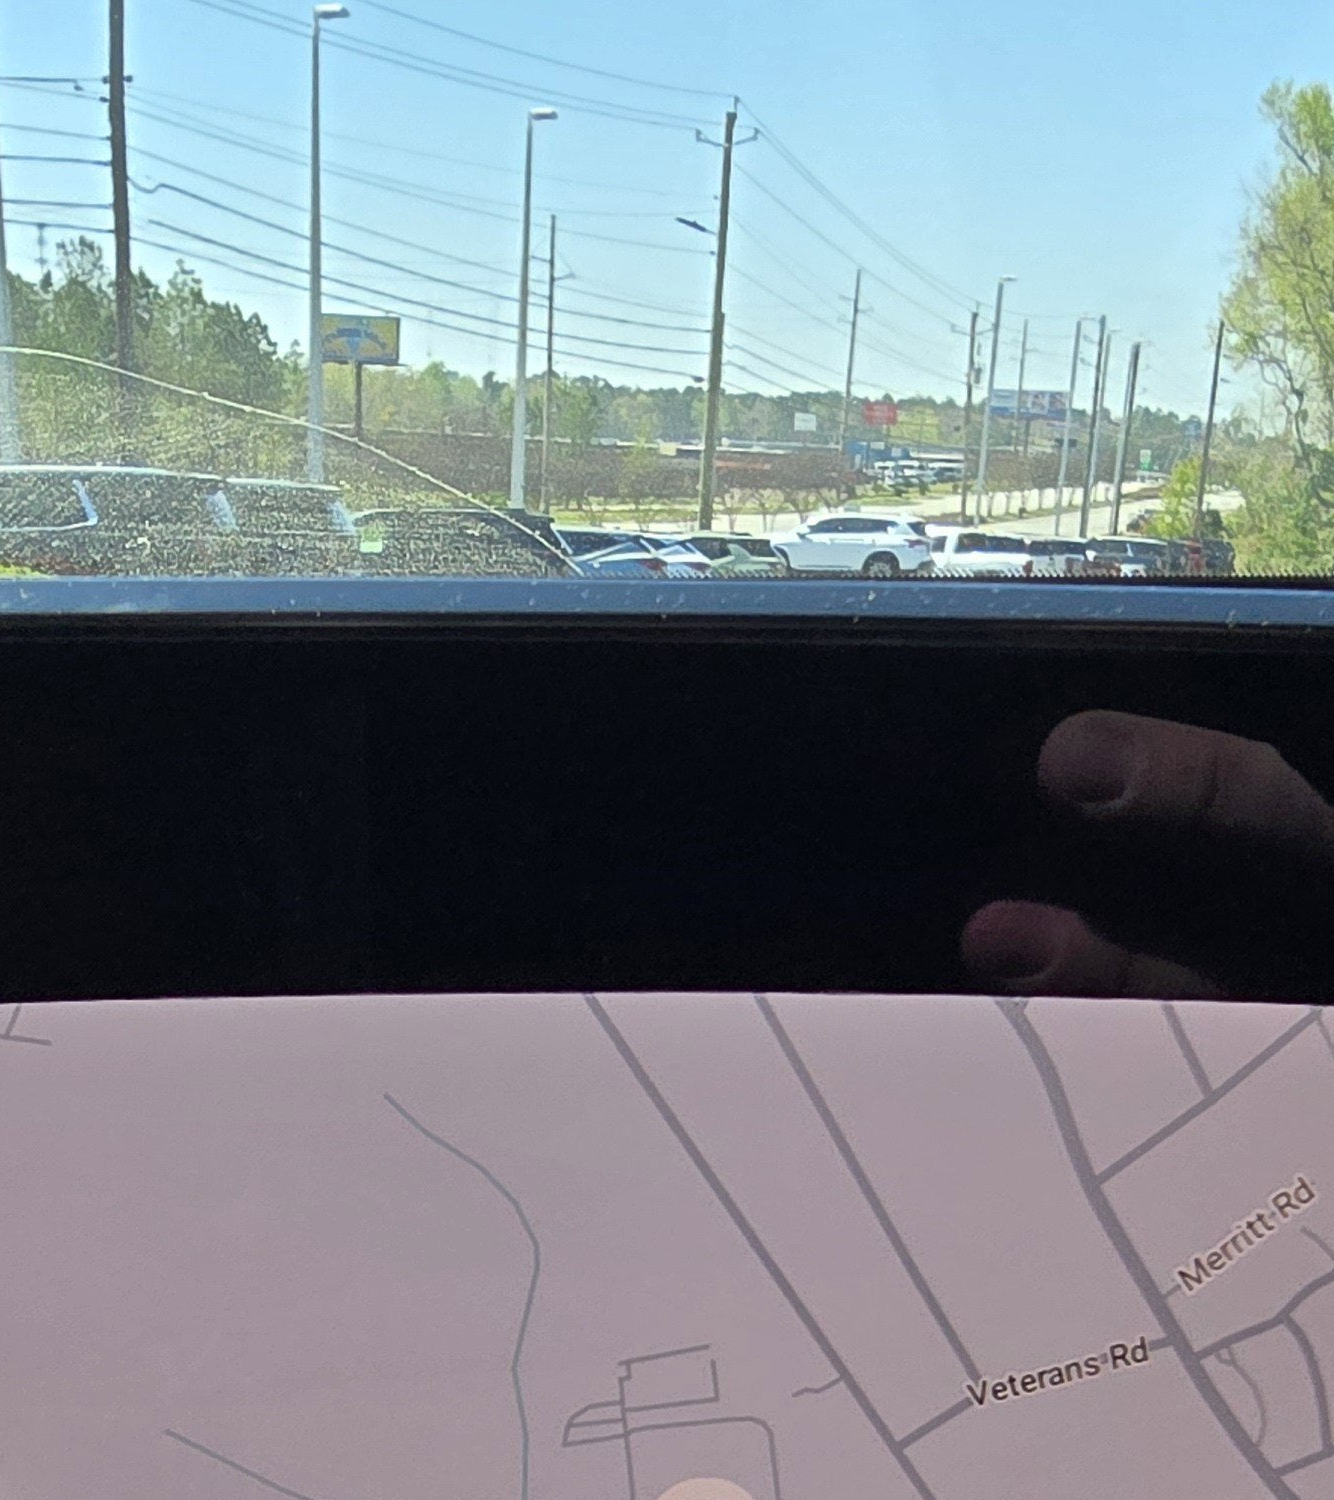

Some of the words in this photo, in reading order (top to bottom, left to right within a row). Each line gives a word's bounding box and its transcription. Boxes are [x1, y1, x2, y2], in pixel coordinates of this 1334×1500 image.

[1177, 1213, 1275, 1292] Merritt
[1272, 1176, 1315, 1219] Rd
[966, 1356, 1101, 1406] Veterans
[1109, 1336, 1149, 1370] Rd
